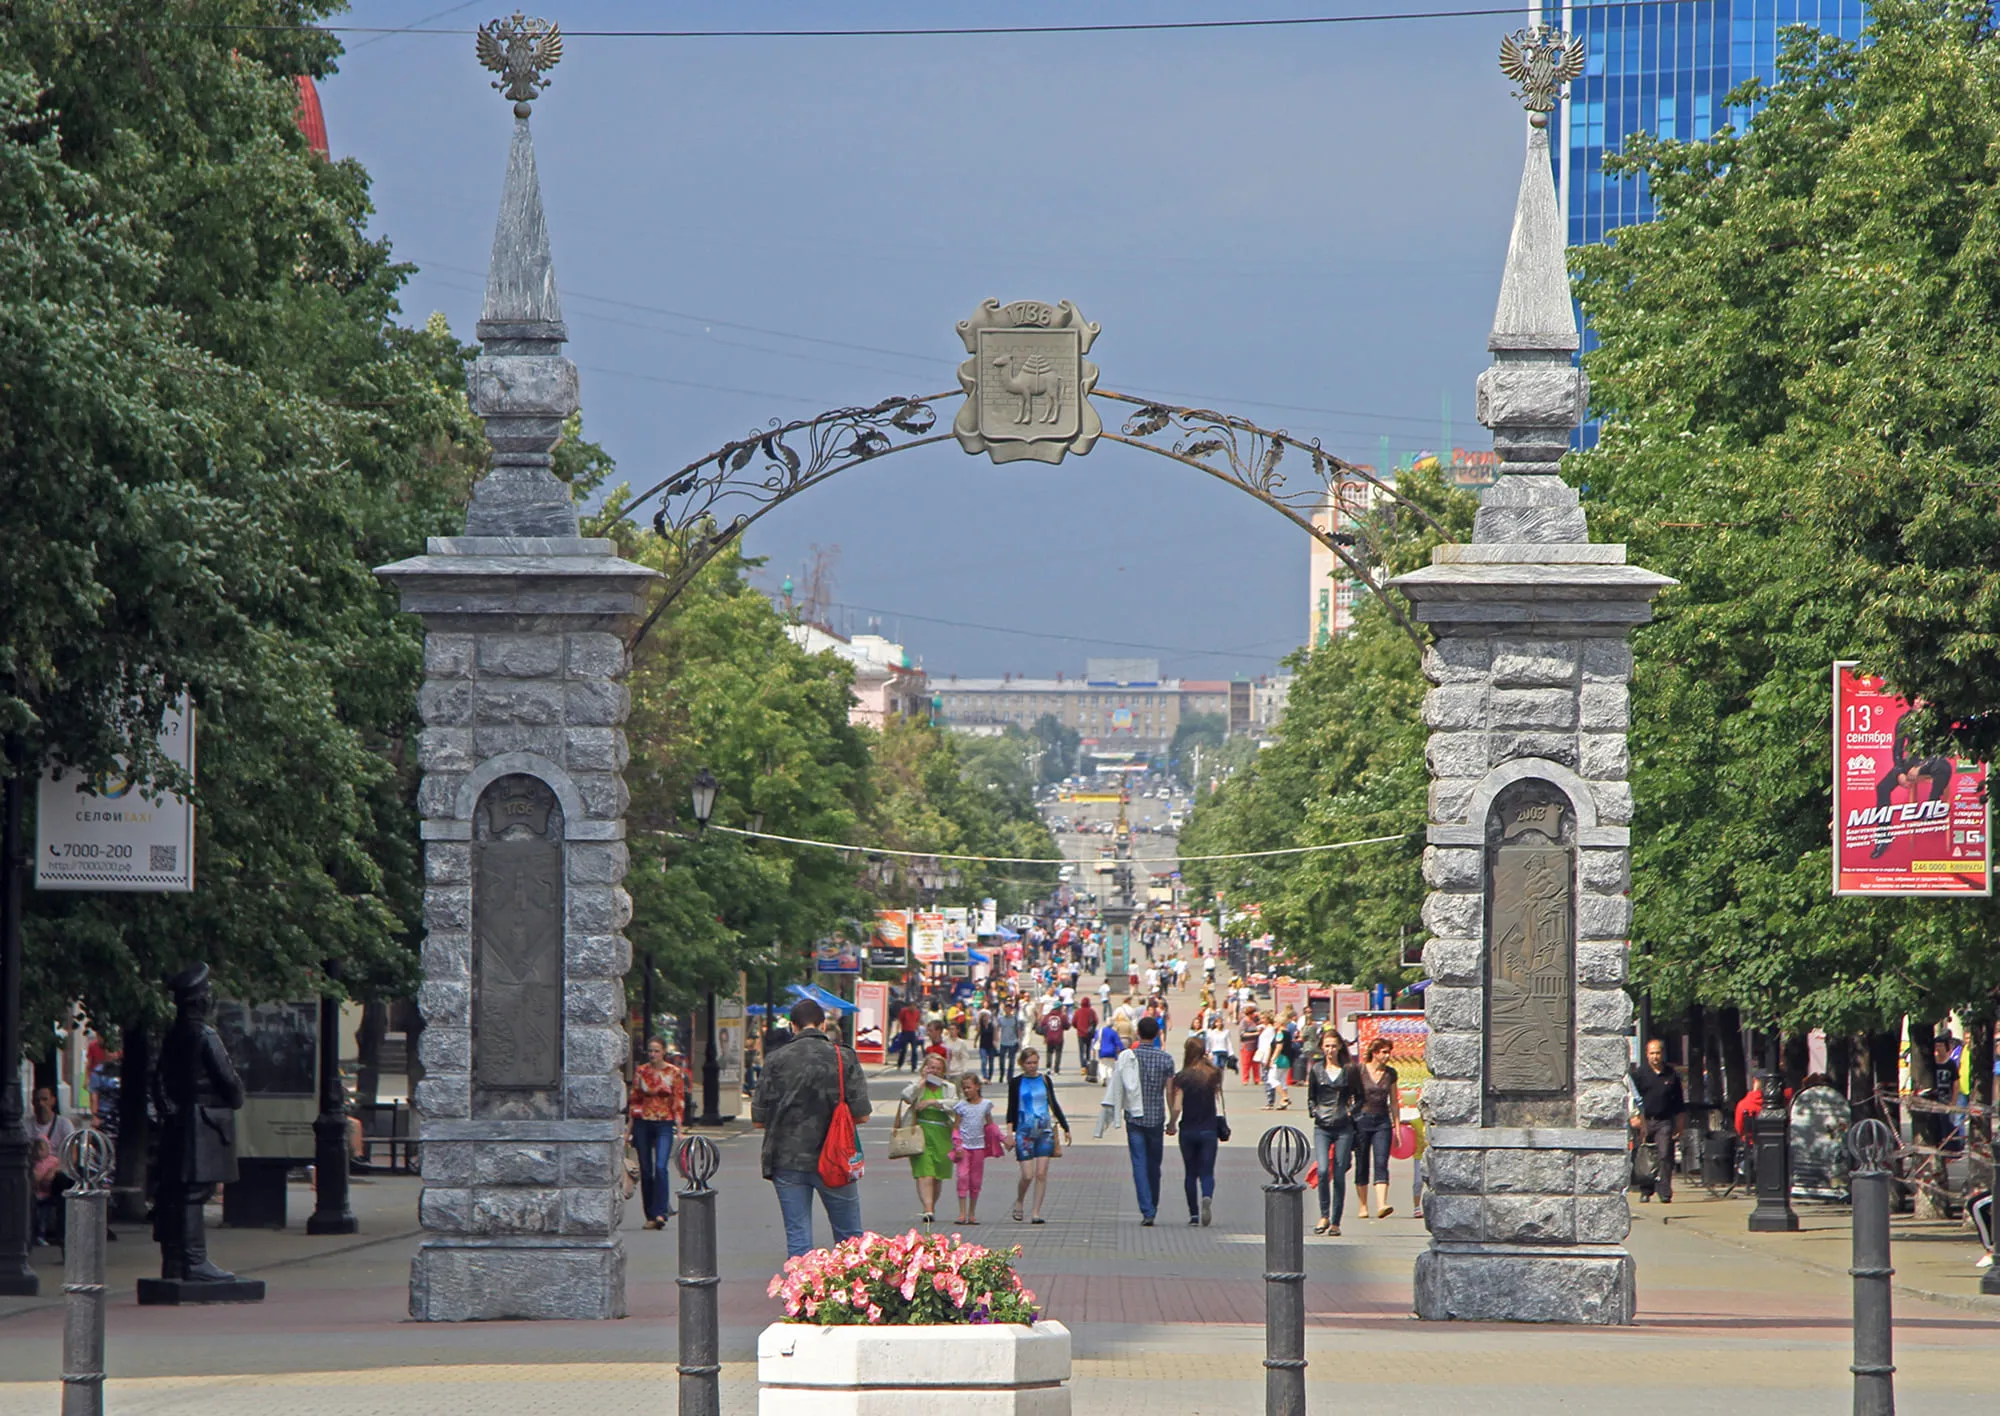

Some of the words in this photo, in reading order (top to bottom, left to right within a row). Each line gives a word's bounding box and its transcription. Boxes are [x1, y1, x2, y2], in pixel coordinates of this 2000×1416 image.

[1007, 303, 1051, 325] 1736
[1846, 704, 1871, 732] 13
[1846, 730, 1893, 745] сентября
[1516, 806, 1547, 822] 2003
[1847, 800, 1951, 828] МИГЕЛЬ
[63, 843, 133, 858] 7000-200
